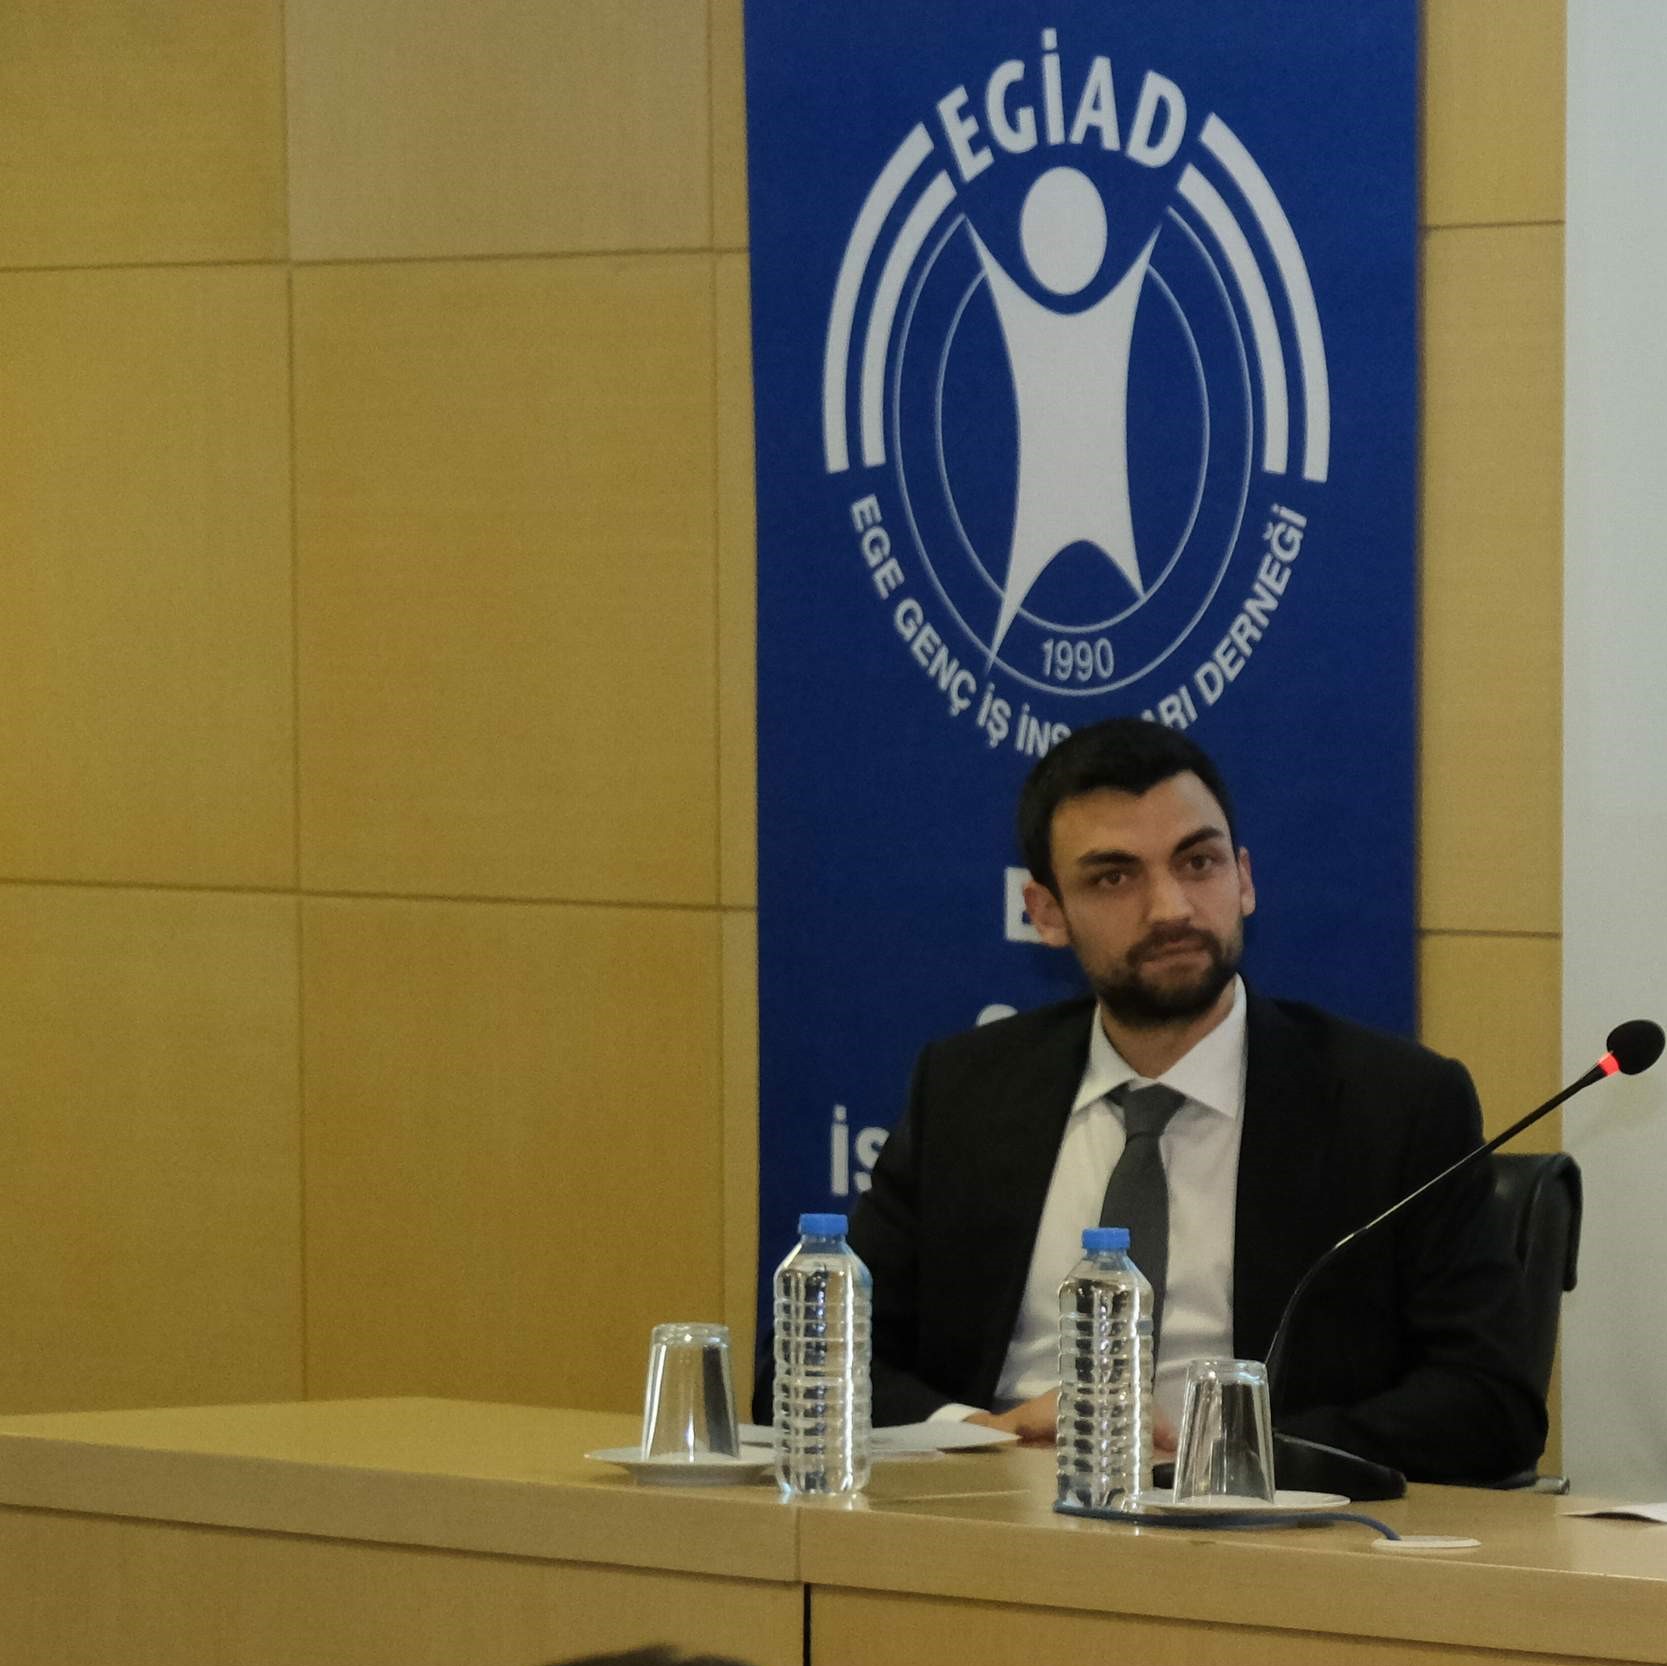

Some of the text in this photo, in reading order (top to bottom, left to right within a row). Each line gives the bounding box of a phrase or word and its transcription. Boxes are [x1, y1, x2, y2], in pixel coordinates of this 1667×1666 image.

[937, 27, 1187, 183] EGİAD
[851, 493, 905, 600] EGE
[893, 597, 977, 717] GENÇ
[976, 683, 1012, 748] İŞ
[1194, 503, 1307, 706] DERNEĞİ
[1042, 637, 1116, 682] 1990
